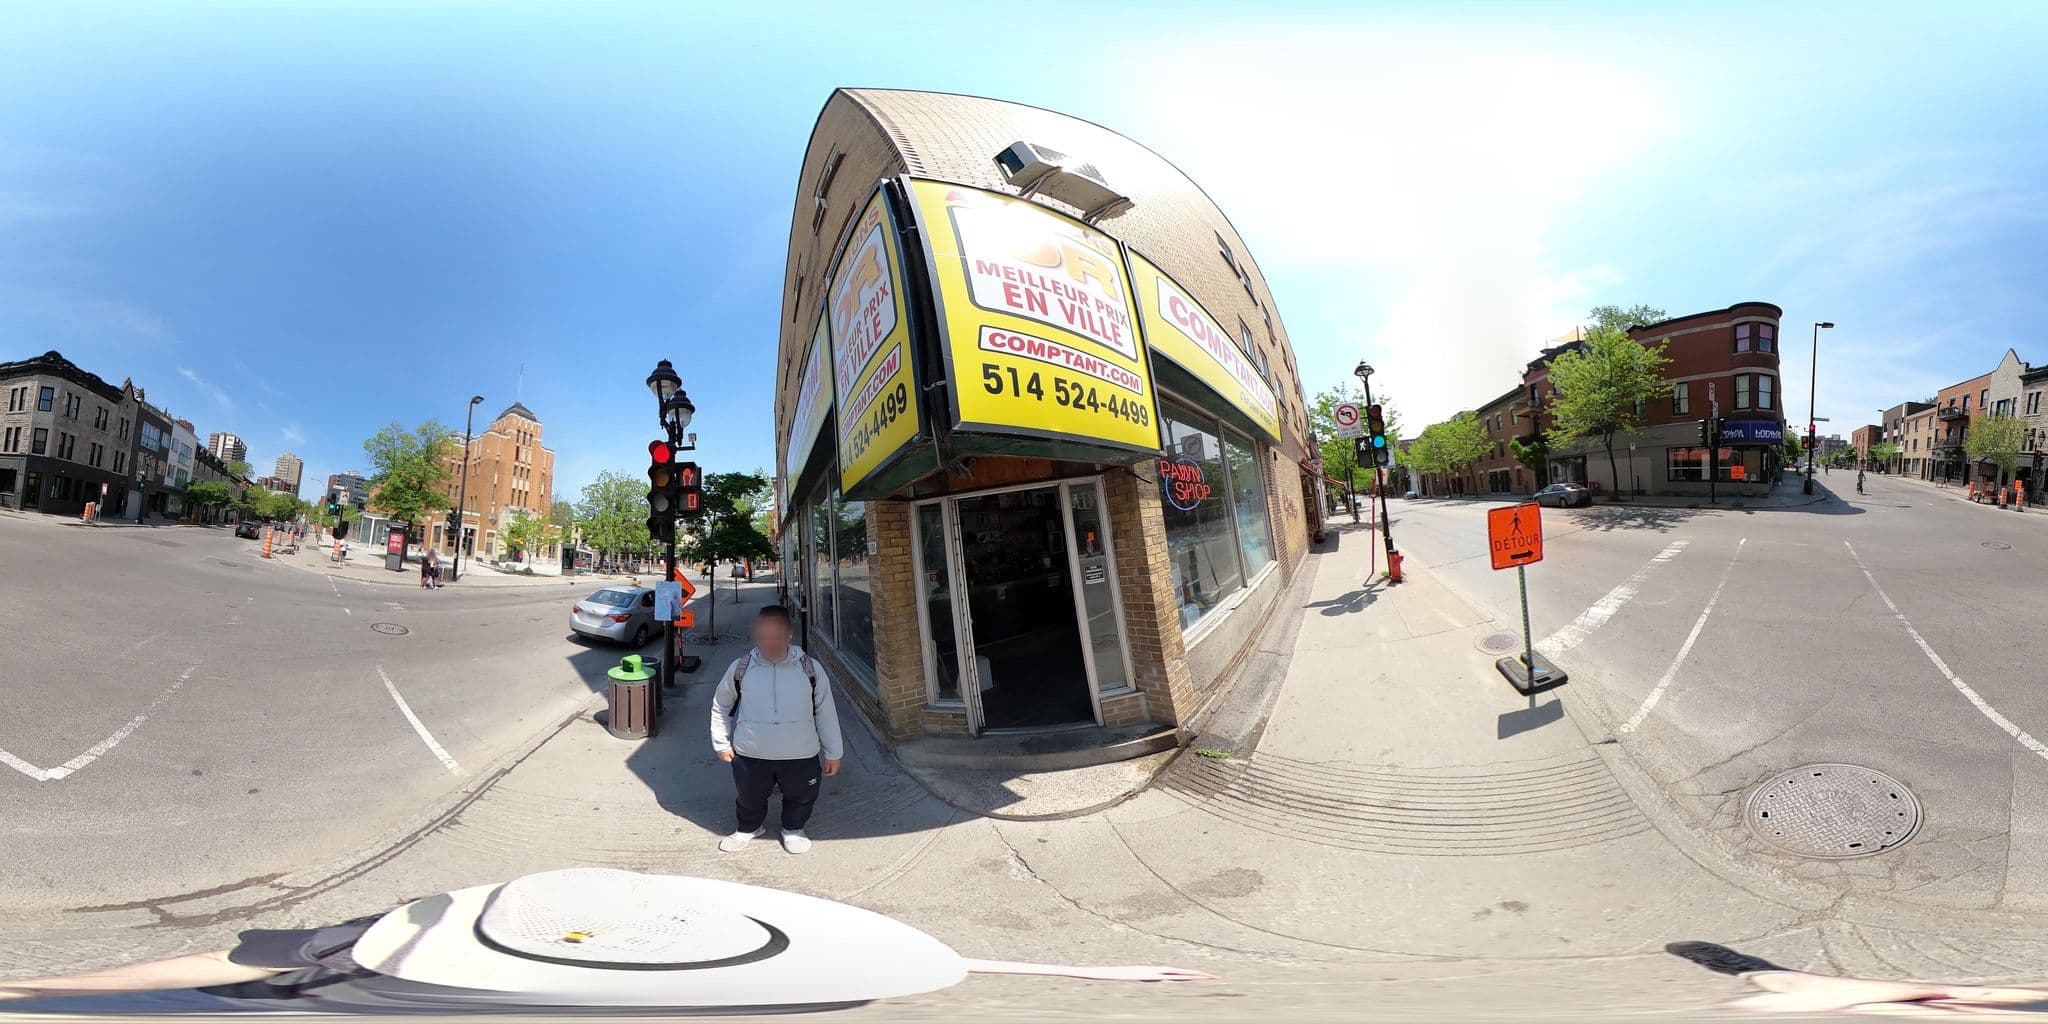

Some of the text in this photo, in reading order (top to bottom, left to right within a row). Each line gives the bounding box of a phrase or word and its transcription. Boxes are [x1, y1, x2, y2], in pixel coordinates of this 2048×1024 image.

[835, 243, 882, 347] OR
[863, 280, 890, 326] PRIX
[975, 259, 1129, 331] MEILLEUR PRIX
[1002, 281, 1124, 348] EN VILLE
[840, 311, 882, 400] EN VILLE
[988, 331, 1140, 391] COMPTANT.COM
[1168, 295, 1275, 415] COMPTANT
[841, 351, 897, 440] COMPTANT.COM
[853, 381, 907, 460] 524-4499
[982, 362, 1149, 428] 514 524-4499
[1159, 459, 1201, 482] PAWN
[1175, 481, 1211, 501] SHOP
